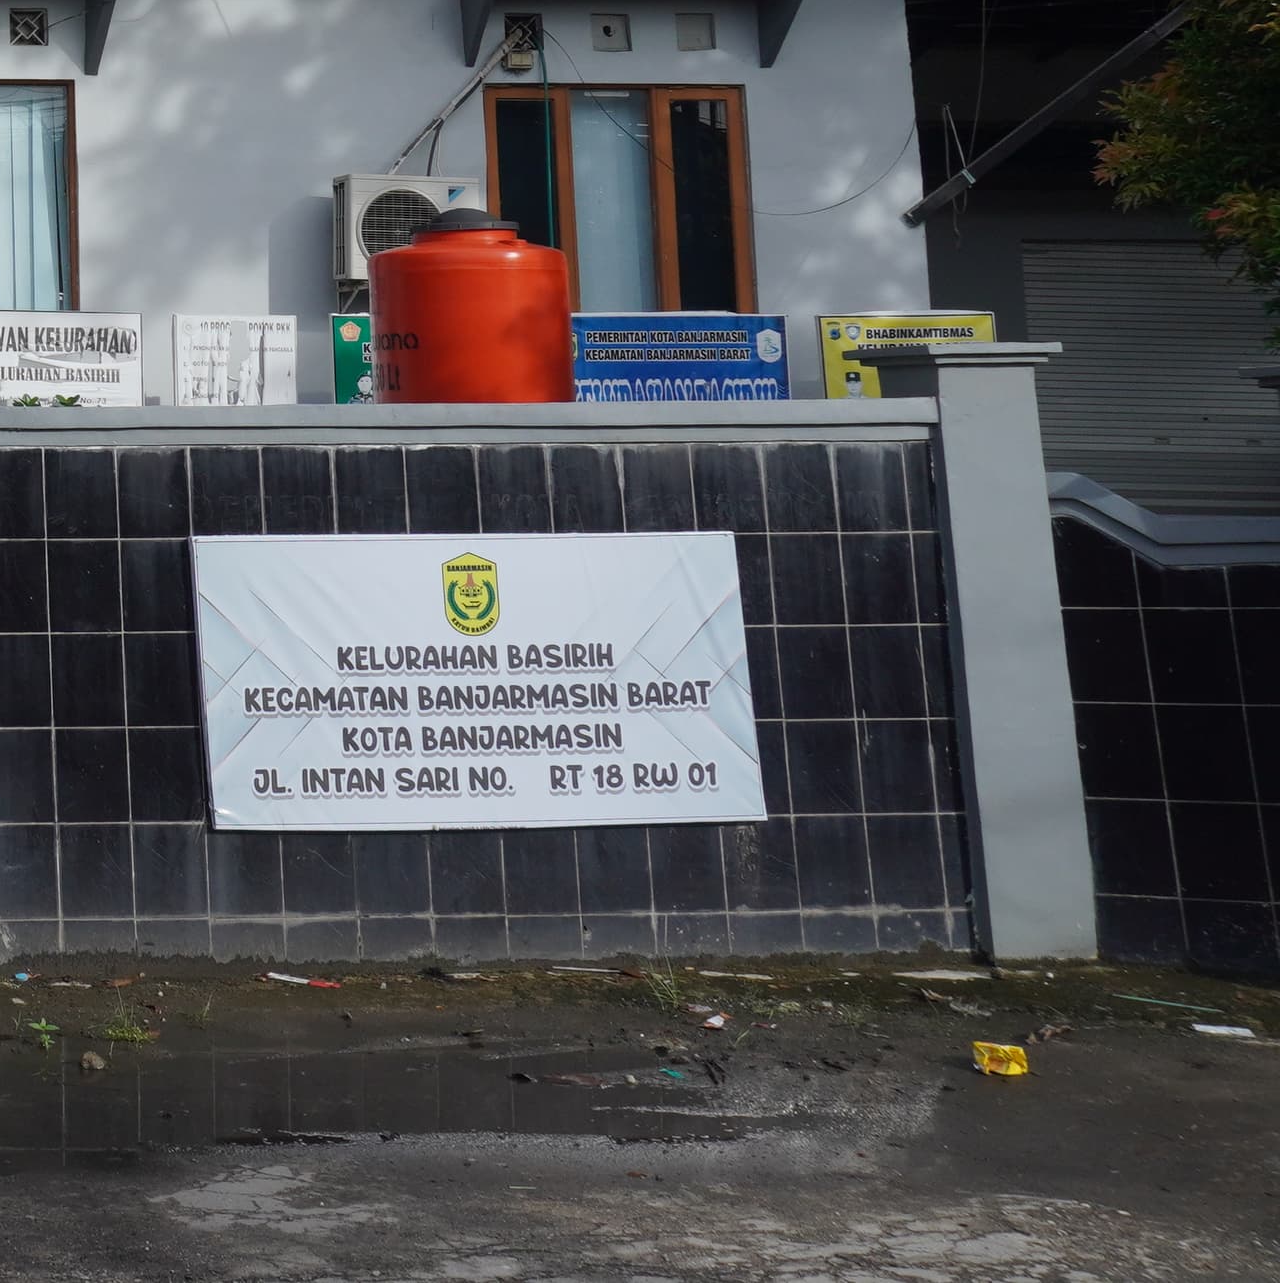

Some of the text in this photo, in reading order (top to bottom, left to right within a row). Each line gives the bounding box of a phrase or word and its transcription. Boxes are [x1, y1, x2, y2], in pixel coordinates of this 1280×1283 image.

[34, 326, 138, 354] KELURAHAN
[585, 330, 748, 343] PEMERINTAH KOTA BANJARMASIN
[865, 327, 974, 339] BHABINKAMTIBMAS
[585, 348, 751, 361] KECAMATAN BANJARMASIN BARAT
[66, 368, 121, 383] BASIRIH
[337, 643, 614, 672] KELURAHAN BASIRIH
[244, 680, 711, 714] KECAMATAN BANJARMASIN BARAT
[342, 724, 622, 752] KOTA BANJARMASIN
[254, 762, 717, 794] JL. INTAN SARI NO. RT 18 RW 01
